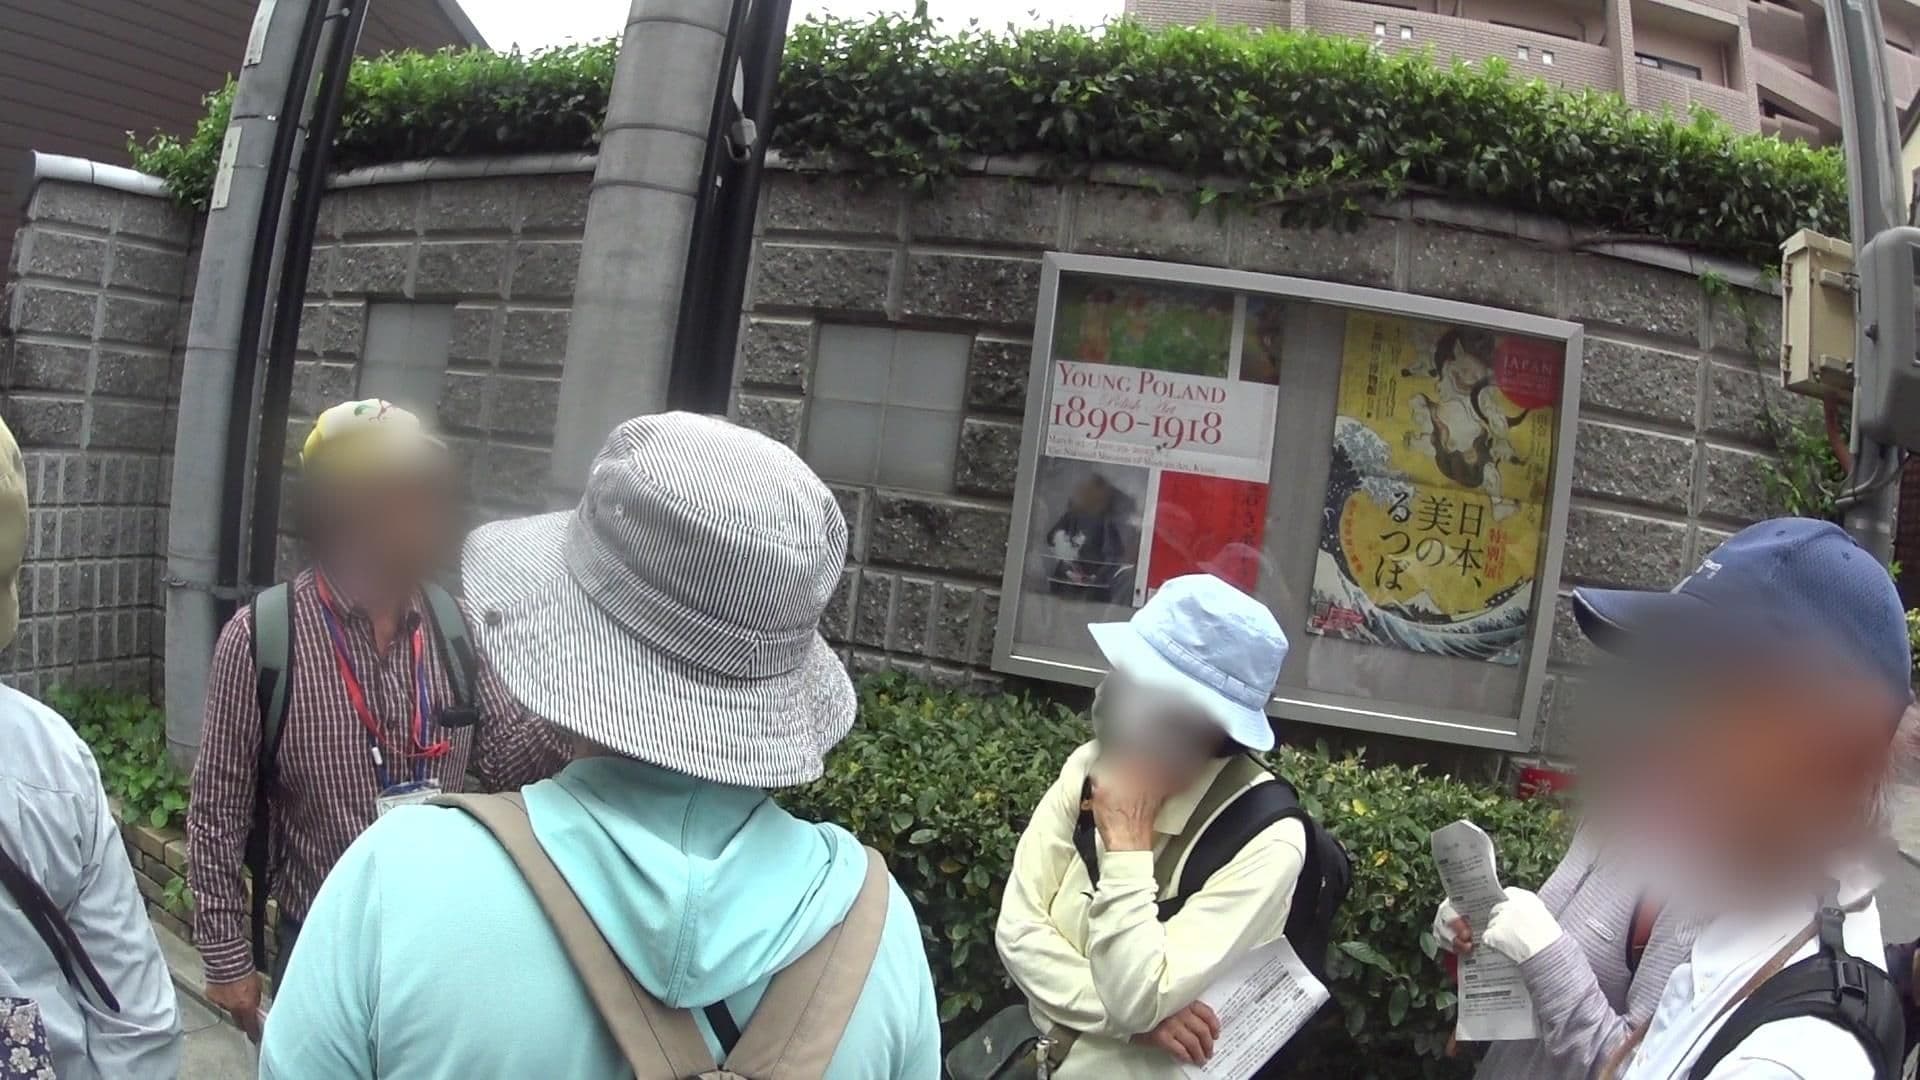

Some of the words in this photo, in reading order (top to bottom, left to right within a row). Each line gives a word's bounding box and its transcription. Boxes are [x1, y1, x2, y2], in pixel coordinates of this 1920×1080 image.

[1052, 396, 1222, 449] 1890-1918
[1375, 491, 1412, 591] るつぼ
[1415, 495, 1453, 567] 美の
[1449, 502, 1484, 588] 日本、
